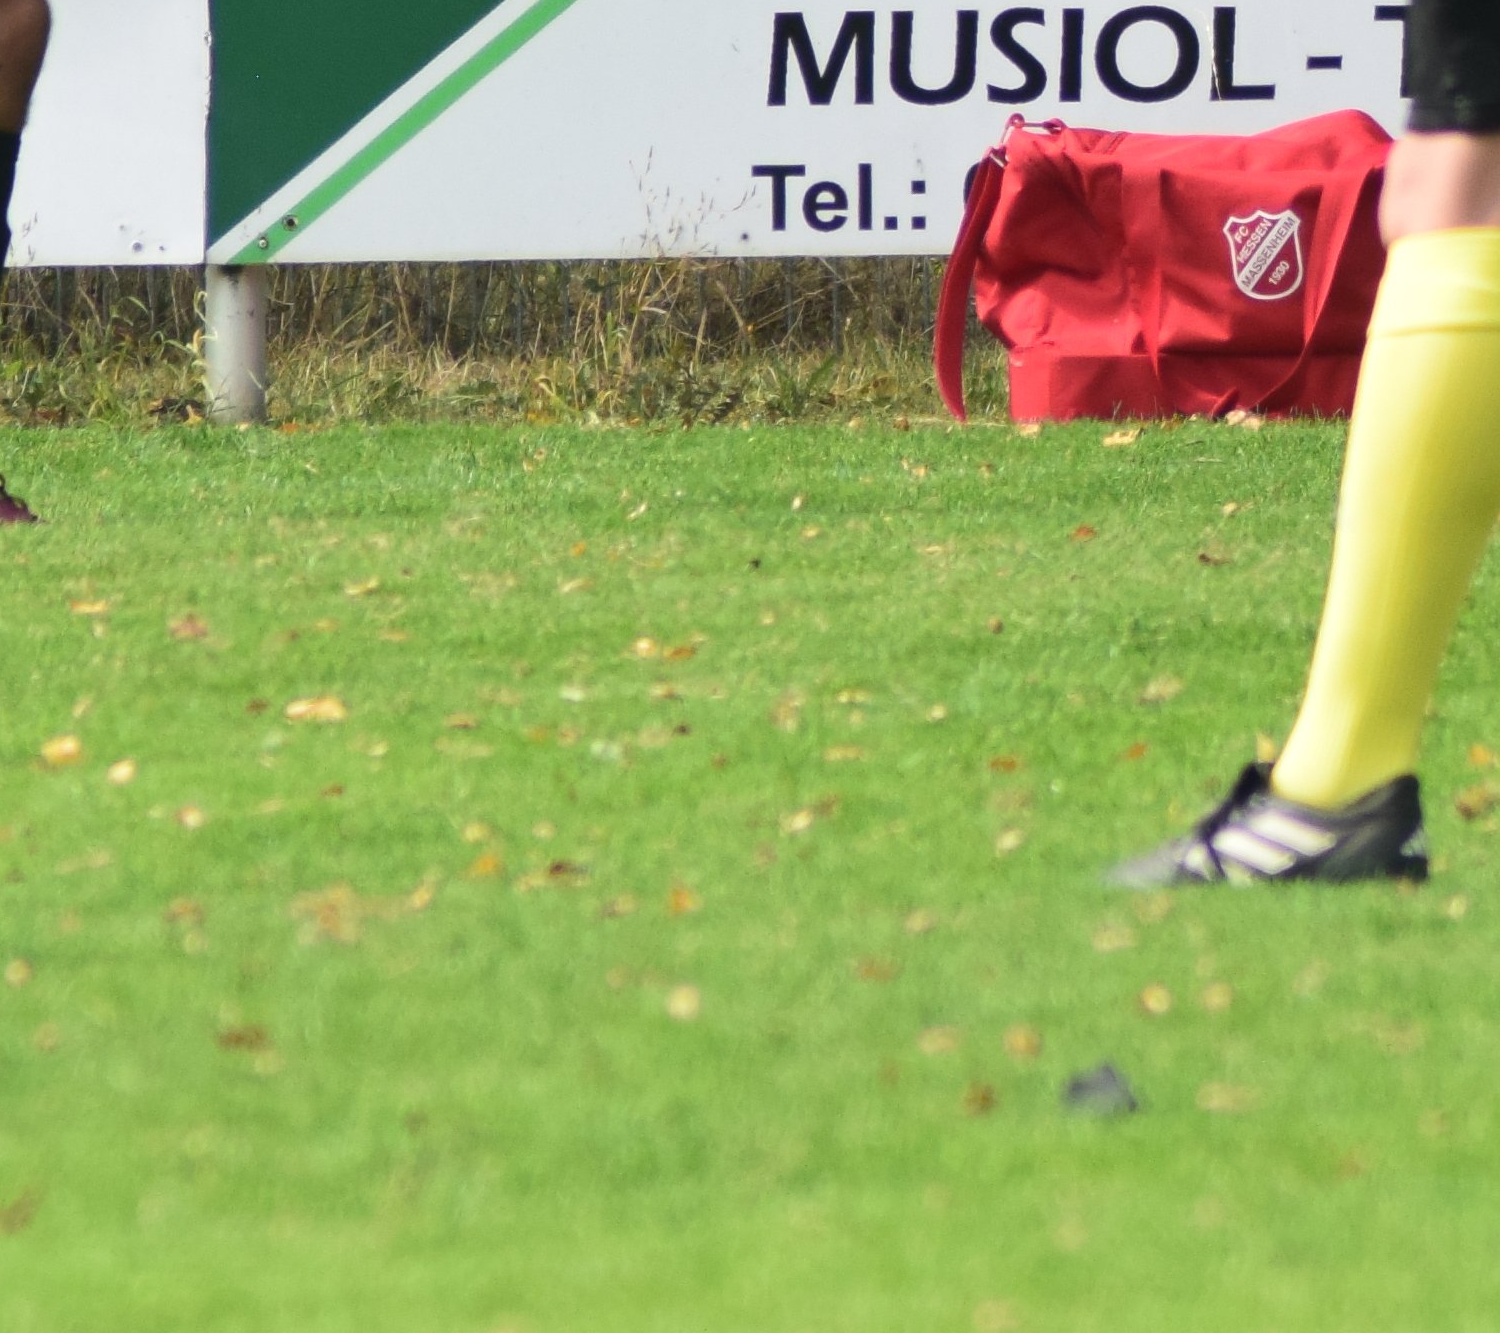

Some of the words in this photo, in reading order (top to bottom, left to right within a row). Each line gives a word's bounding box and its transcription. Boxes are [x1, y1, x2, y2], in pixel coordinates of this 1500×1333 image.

[766, 5, 1276, 107] MUSIOL
[751, 162, 927, 233] Tel.:
[1234, 225, 1249, 244] FC
[1236, 218, 1273, 264] HESSEN
[1241, 216, 1296, 287] MASSENHEIM
